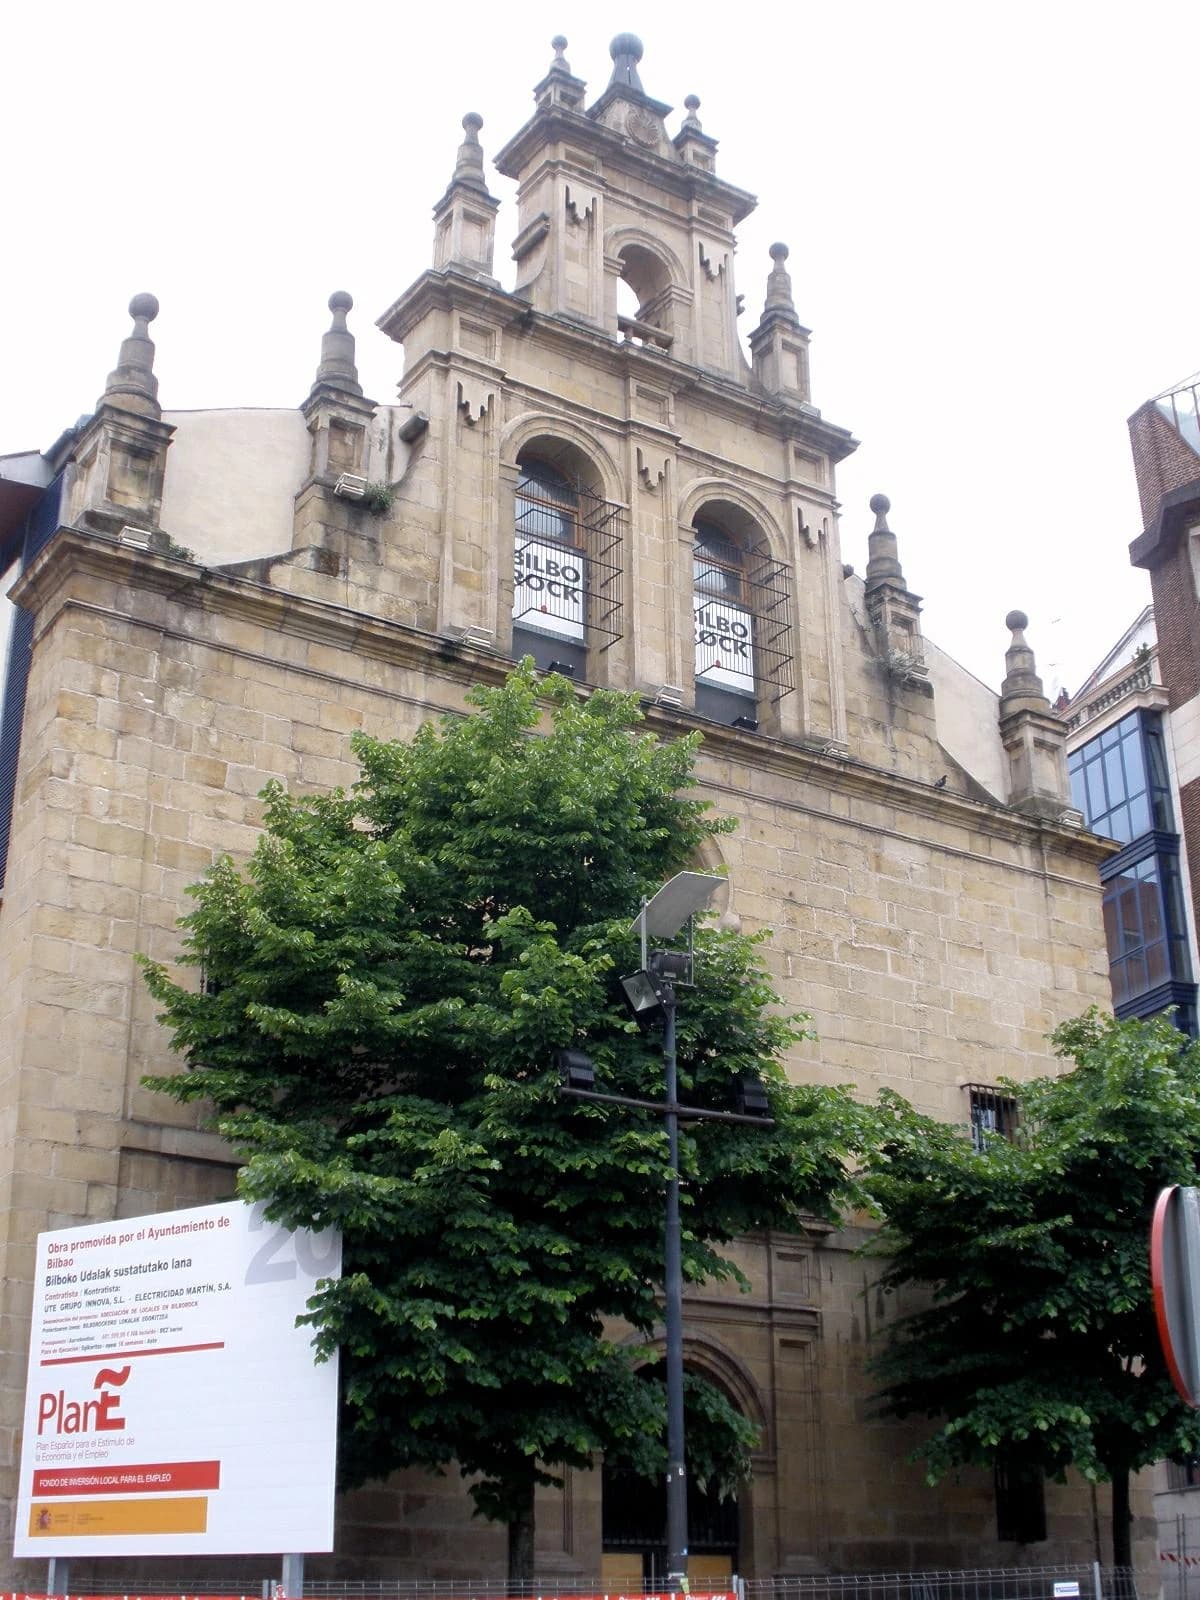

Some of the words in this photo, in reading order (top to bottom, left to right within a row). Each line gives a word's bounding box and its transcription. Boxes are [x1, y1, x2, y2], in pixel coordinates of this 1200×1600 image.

[695, 609, 748, 638] ILBO
[695, 628, 749, 658] OCK
[48, 1243, 68, 1254] Obra
[70, 1234, 116, 1253] promovida
[119, 1232, 134, 1246] por
[136, 1229, 145, 1240] el
[148, 1218, 215, 1240] Ayuntamiento
[217, 1216, 230, 1228] de
[45, 1273, 78, 1287] Bilboko
[80, 1267, 111, 1282] Udalak
[113, 1260, 169, 1278] sustatutako
[171, 1258, 192, 1270] lana
[47, 1258, 74, 1269] Bilbao
[44, 1290, 79, 1301] Contratista
[84, 1286, 121, 1296] Kontratista:
[44, 1304, 57, 1312] UTE
[60, 1301, 82, 1311] GRUPO
[135, 1288, 184, 1302] ELECTRICIDAD
[36, 1441, 49, 1451] Plan
[50, 1441, 74, 1451] Español
[76, 1440, 90, 1450] para
[126, 1437, 135, 1446] de
[85, 1450, 108, 1460] Empleo
[39, 1478, 60, 1488] FONDO
[60, 1477, 68, 1486] DE
[100, 1475, 120, 1485] LOCAL
[121, 1474, 137, 1484] PARA
[137, 1474, 145, 1483] EL
[146, 1473, 172, 1483] EMPLEO
